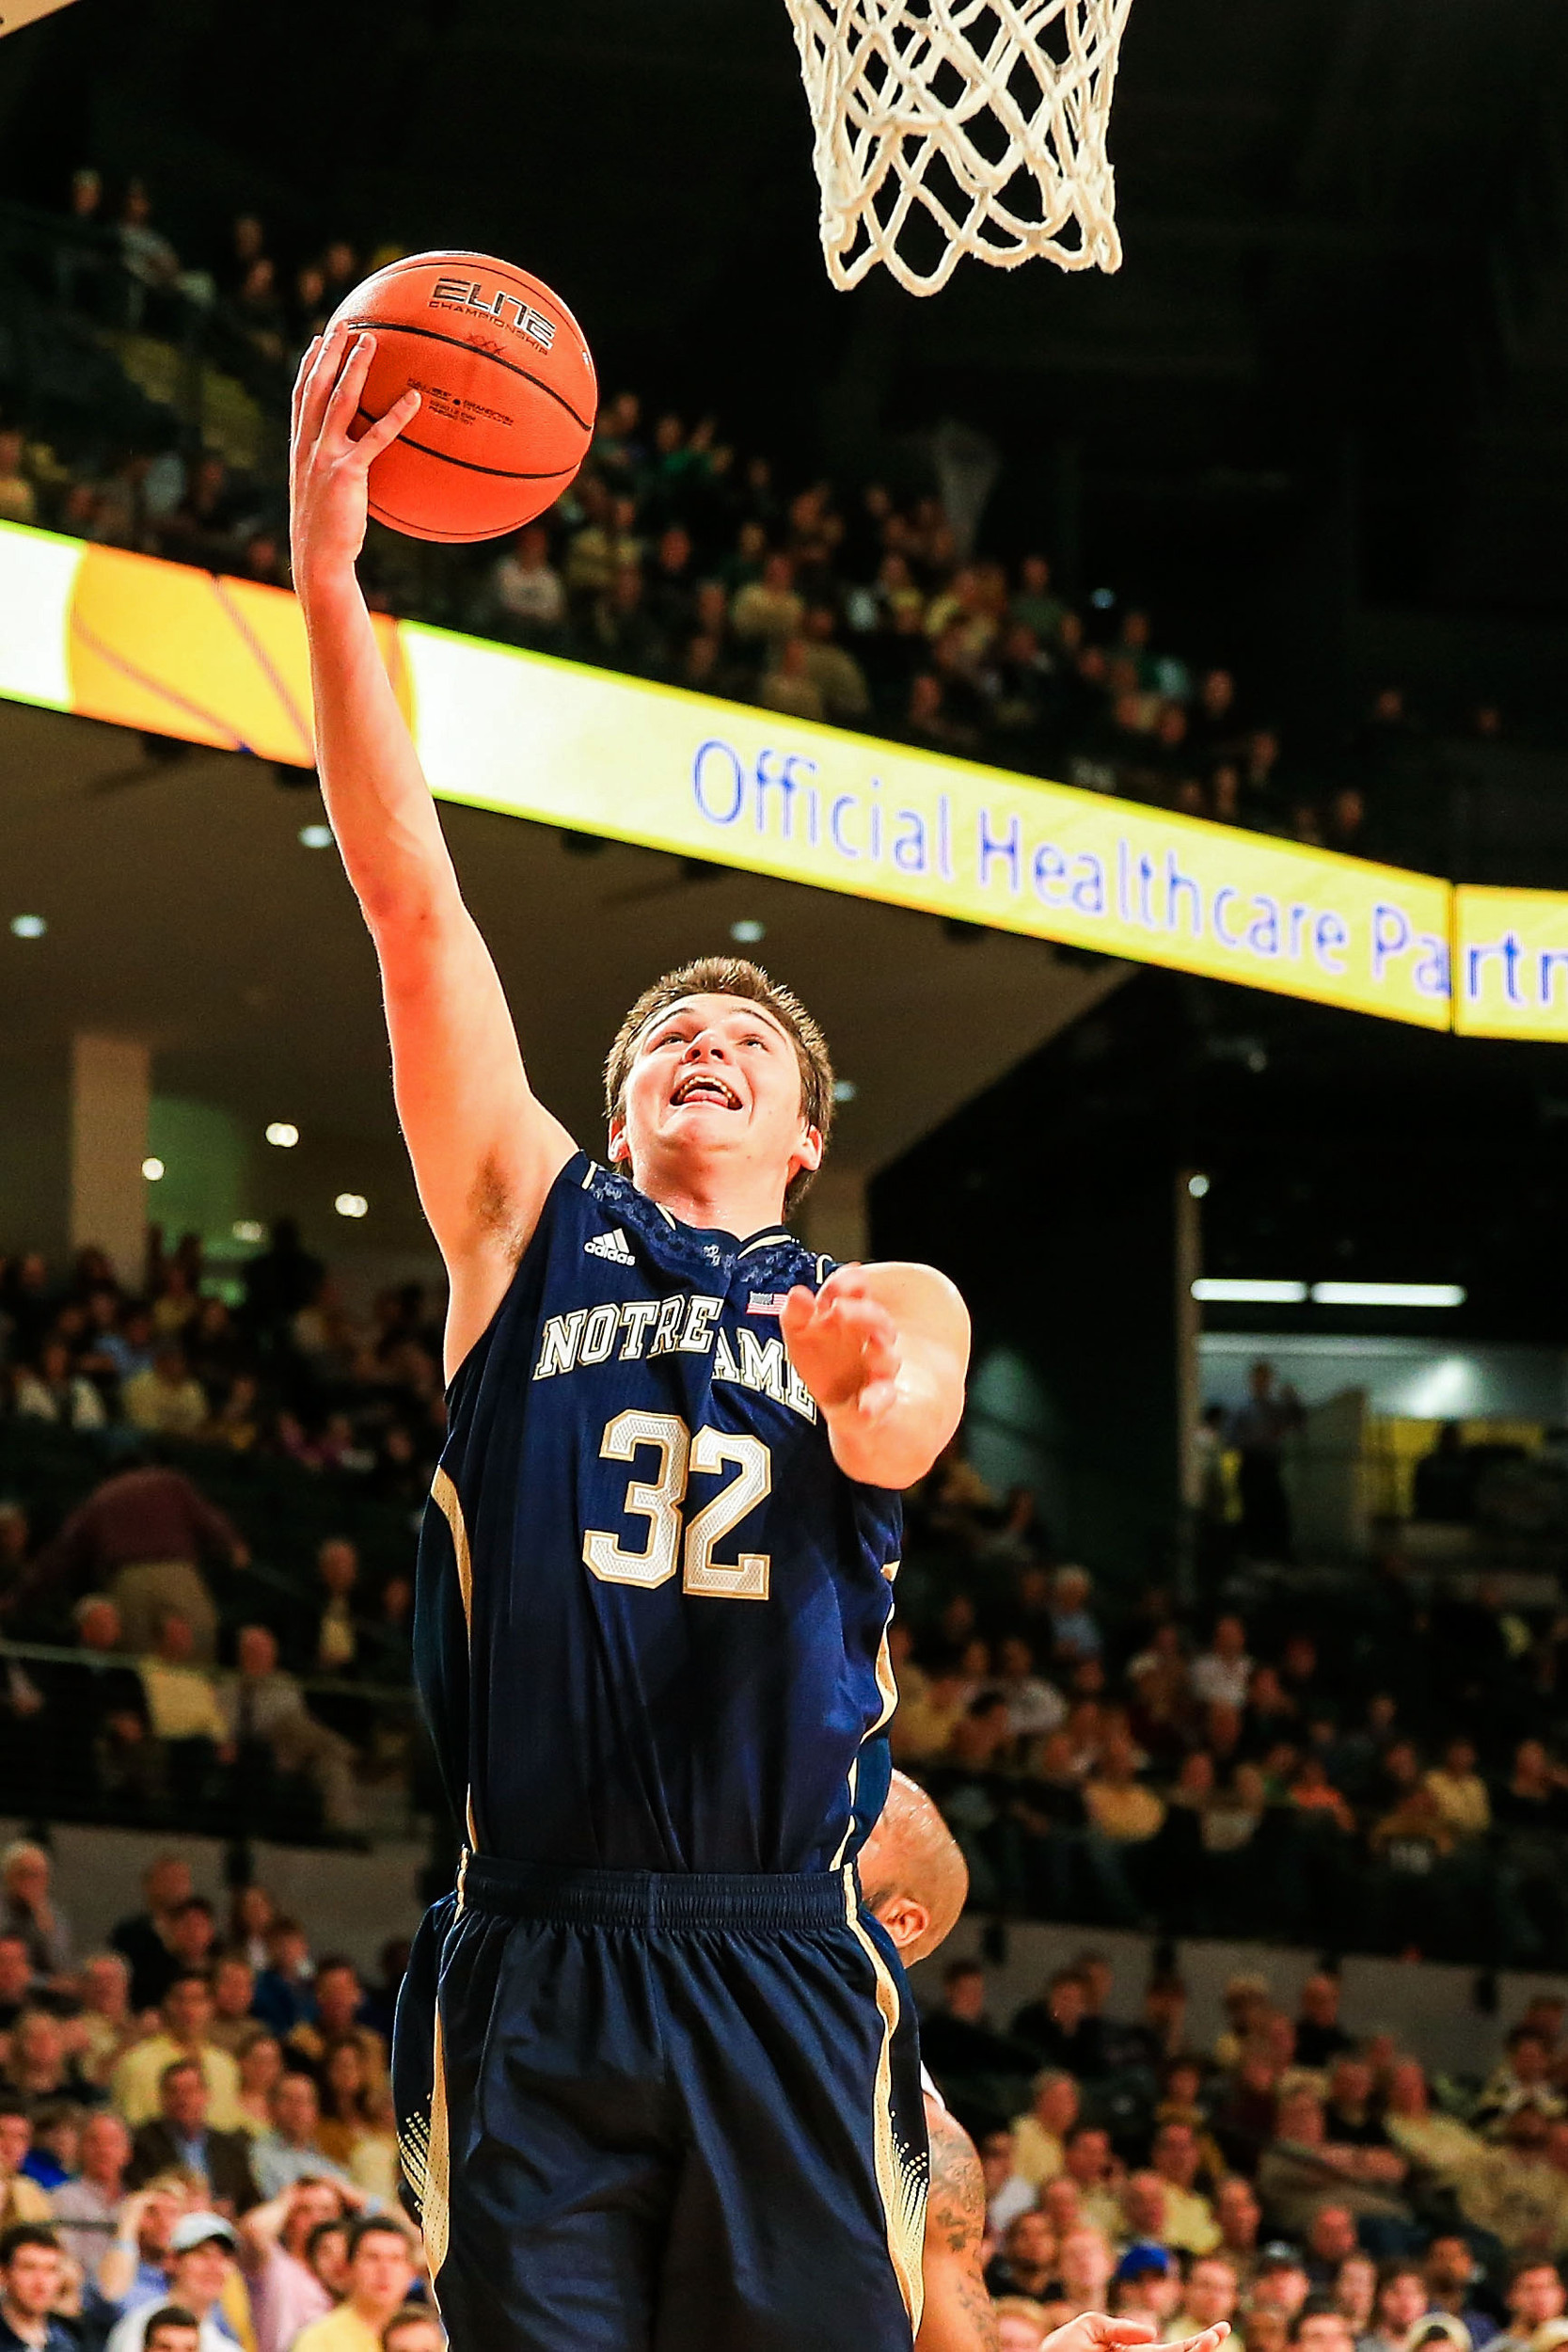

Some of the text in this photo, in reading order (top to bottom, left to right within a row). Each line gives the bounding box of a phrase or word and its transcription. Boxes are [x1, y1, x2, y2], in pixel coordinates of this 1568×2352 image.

[428, 300, 548, 356] CHAMPIONSHIP
[432, 276, 556, 349] ELITE
[692, 739, 953, 881] Official
[978, 807, 1346, 973] Healthcare
[583, 1241, 636, 1266] adidas
[532, 1294, 816, 1425] NOTRE AME
[582, 1408, 772, 1600] 32
